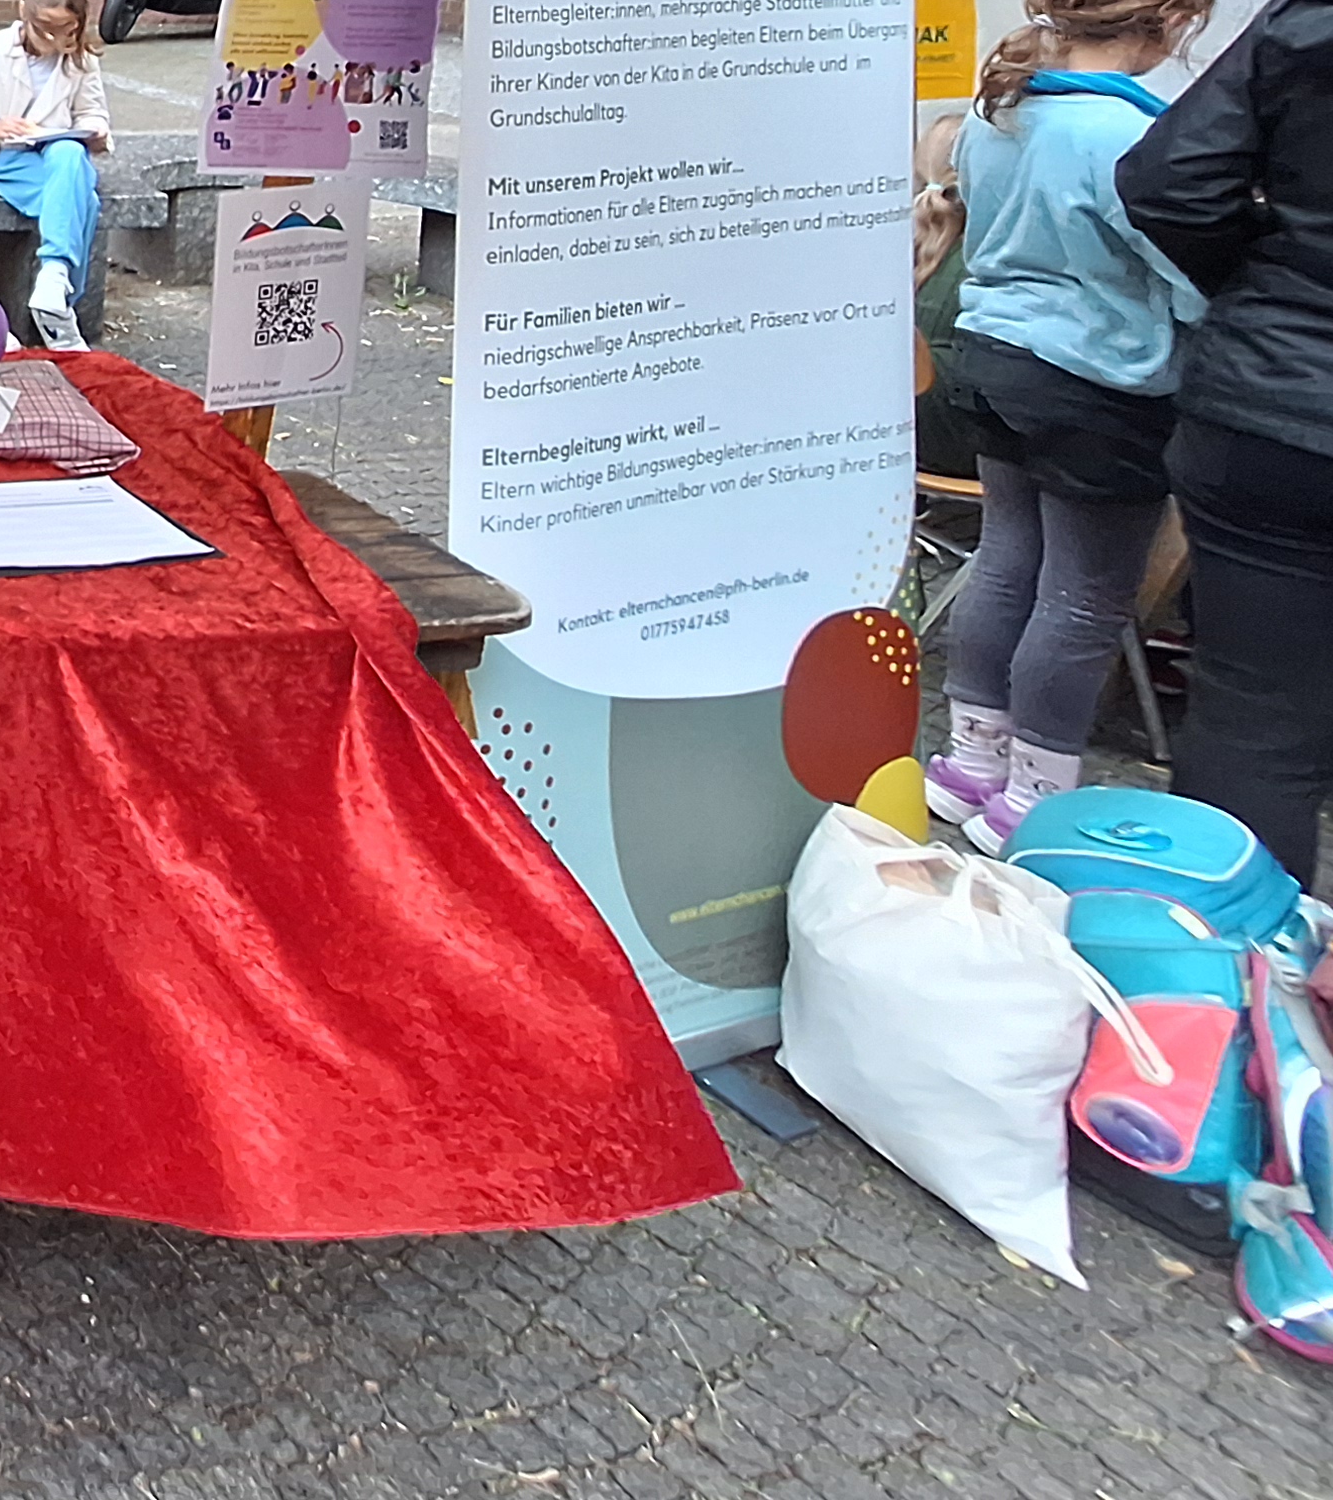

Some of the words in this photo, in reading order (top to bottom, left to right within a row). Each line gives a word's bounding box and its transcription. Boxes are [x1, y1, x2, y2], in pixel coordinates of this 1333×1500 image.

[691, 28, 755, 50] begleiten
[760, 26, 803, 43] Eltern
[808, 24, 843, 41] beim
[915, 24, 950, 44] AK
[491, 75, 532, 93] ihrer
[538, 71, 589, 90] Kinder
[593, 74, 620, 87] von
[624, 66, 647, 85] der
[651, 65, 678, 83] Kita
[682, 63, 693, 80] in
[698, 61, 718, 79] die
[722, 56, 815, 77] Grundschule
[820, 54, 847, 72] und
[856, 58, 871, 70] im
[490, 103, 628, 127] Grundschulalltag.
[489, 177, 520, 196] Mit
[526, 176, 595, 193] unserem
[600, 165, 653, 189] Projekt
[657, 161, 704, 180] wollen
[489, 207, 602, 230] Informationen
[608, 201, 628, 219] für
[632, 198, 655, 216] alle
[659, 195, 698, 213] Eltern
[702, 185, 779, 211] zugänglich
[783, 181, 842, 200] machen
[847, 178, 873, 196] und
[486, 242, 563, 264] einladen,
[569, 236, 610, 257] dabei
[615, 238, 630, 252] zu
[635, 230, 663, 249] sein,
[669, 225, 695, 245] sich
[699, 228, 715, 241] zu
[720, 218, 788, 238] beteiligen
[794, 212, 822, 231] und
[484, 336, 622, 365] niedrigschwellige
[627, 316, 745, 348] Ansprechbarkeit,
[751, 311, 809, 329] Präsenz
[813, 309, 839, 323] vor
[843, 303, 868, 320] Ort
[872, 298, 896, 317] und
[485, 314, 518, 332] Für
[524, 307, 590, 329] Familien
[596, 301, 642, 320] bieten
[647, 293, 671, 312] wir
[484, 369, 628, 399] bedarfsorientierte
[632, 357, 704, 381] Angebote.
[482, 436, 621, 466] Elternbegleitung
[626, 424, 668, 445] wirkt,
[674, 415, 705, 436] weil
[481, 481, 535, 500] Eltern
[541, 470, 603, 494] wichtige
[807, 431, 842, 447] ihrer
[846, 423, 893, 442] Kinder
[481, 513, 542, 533] Kinder
[547, 500, 622, 527] profitieren
[627, 482, 706, 510] unmittelbar
[710, 479, 736, 494] von
[740, 472, 764, 489] der
[768, 464, 835, 484] Stärkung
[840, 458, 874, 474] ihrer
[558, 609, 614, 633] Kontakt:
